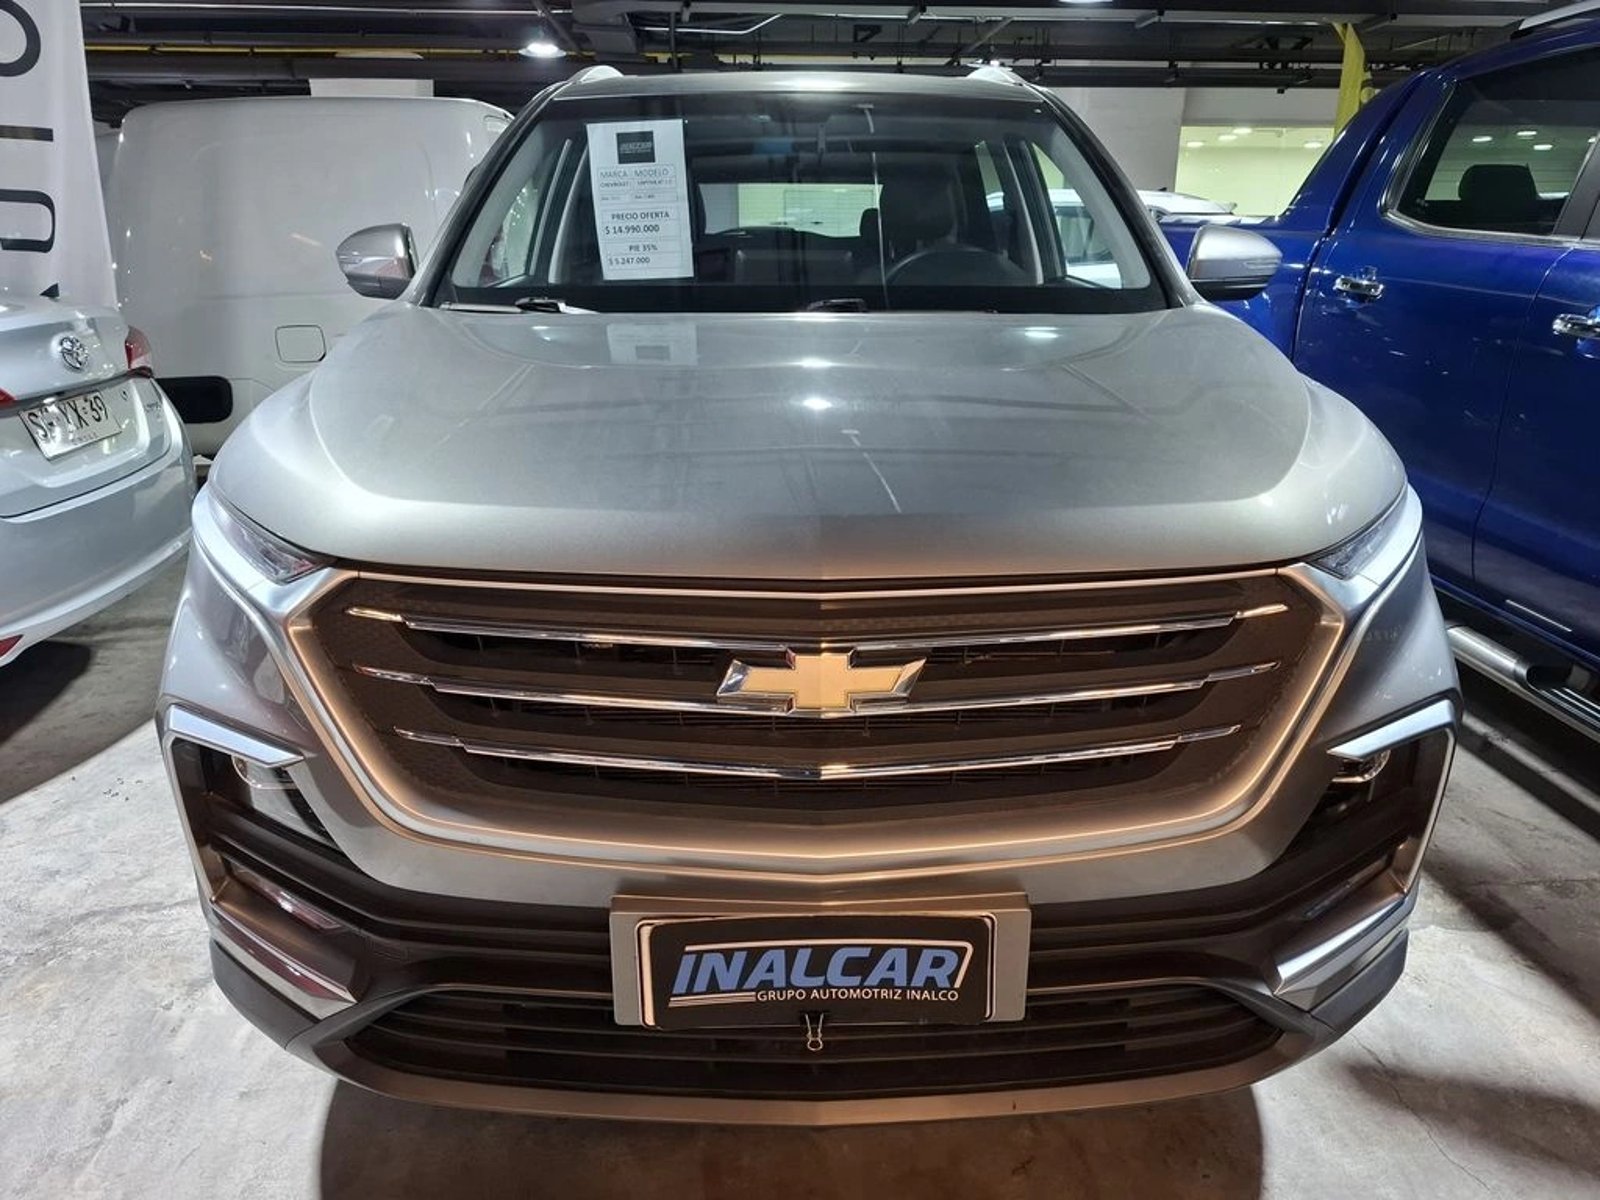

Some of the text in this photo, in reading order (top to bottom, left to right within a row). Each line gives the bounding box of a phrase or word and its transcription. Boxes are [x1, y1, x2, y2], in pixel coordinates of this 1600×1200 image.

[611, 210, 670, 221] PRECIO OFERTA
[605, 224, 660, 235] $ 14.990.000
[671, 945, 960, 994] INALCAR
[757, 987, 959, 1002] GRUPO AUTOMOTRIZ INALCO
